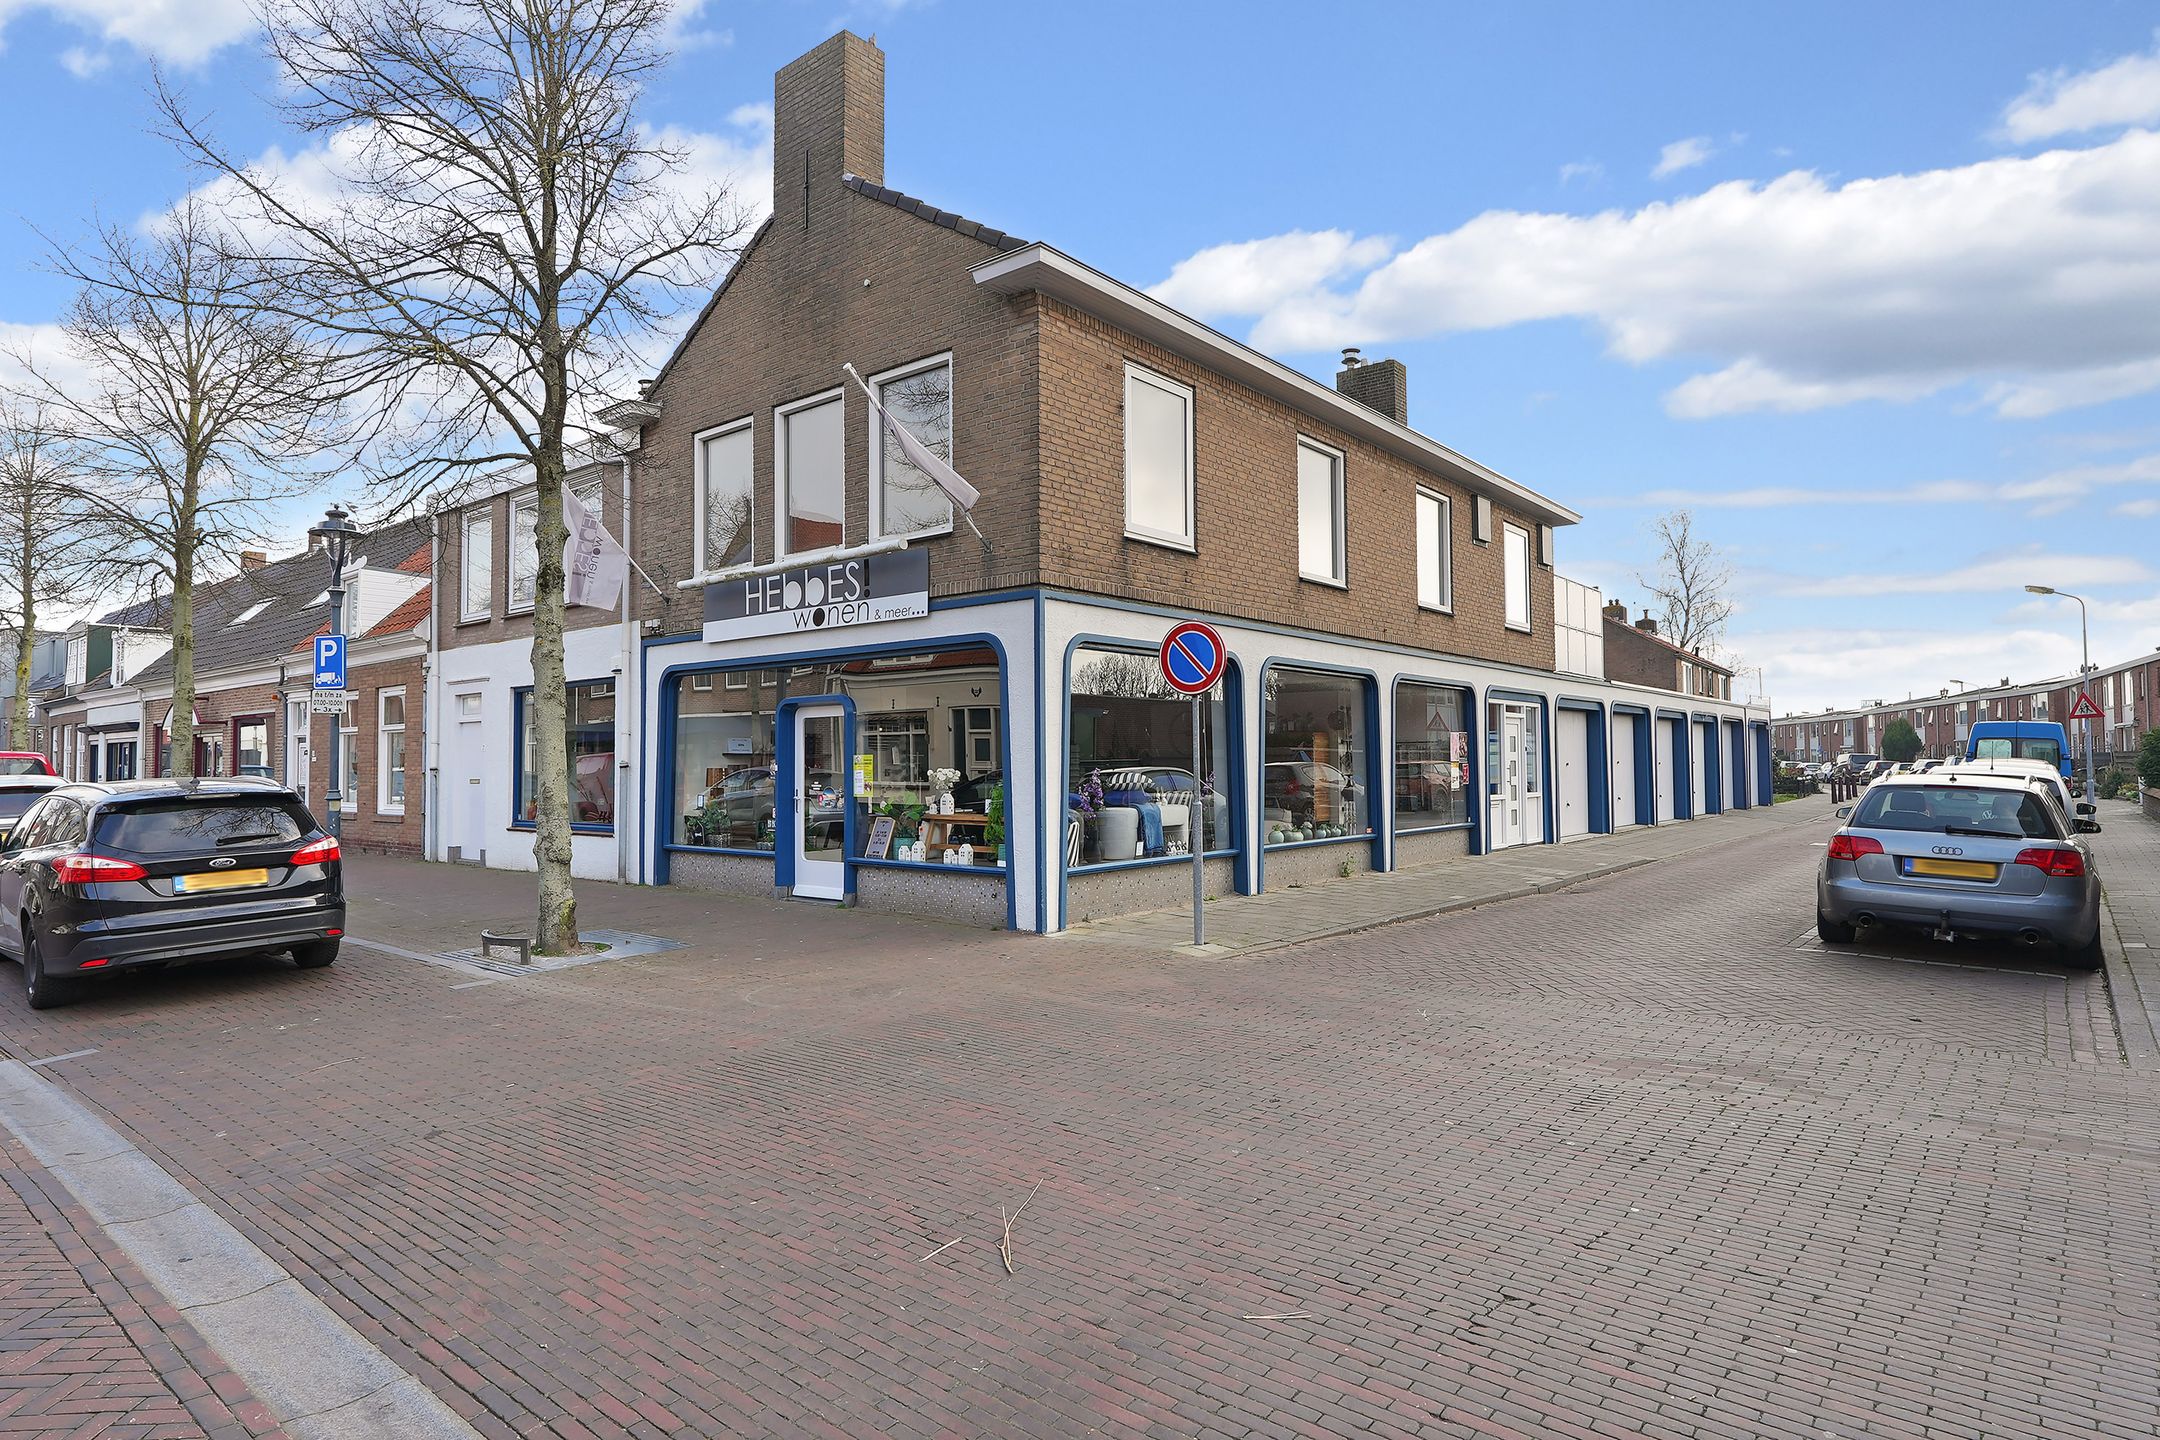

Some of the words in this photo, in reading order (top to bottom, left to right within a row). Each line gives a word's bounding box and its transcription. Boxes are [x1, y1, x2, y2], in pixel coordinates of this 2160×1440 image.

[793, 601, 869, 629] wonen
[874, 610, 882, 620] &
[884, 605, 925, 618] meer...
[320, 640, 338, 667] P
